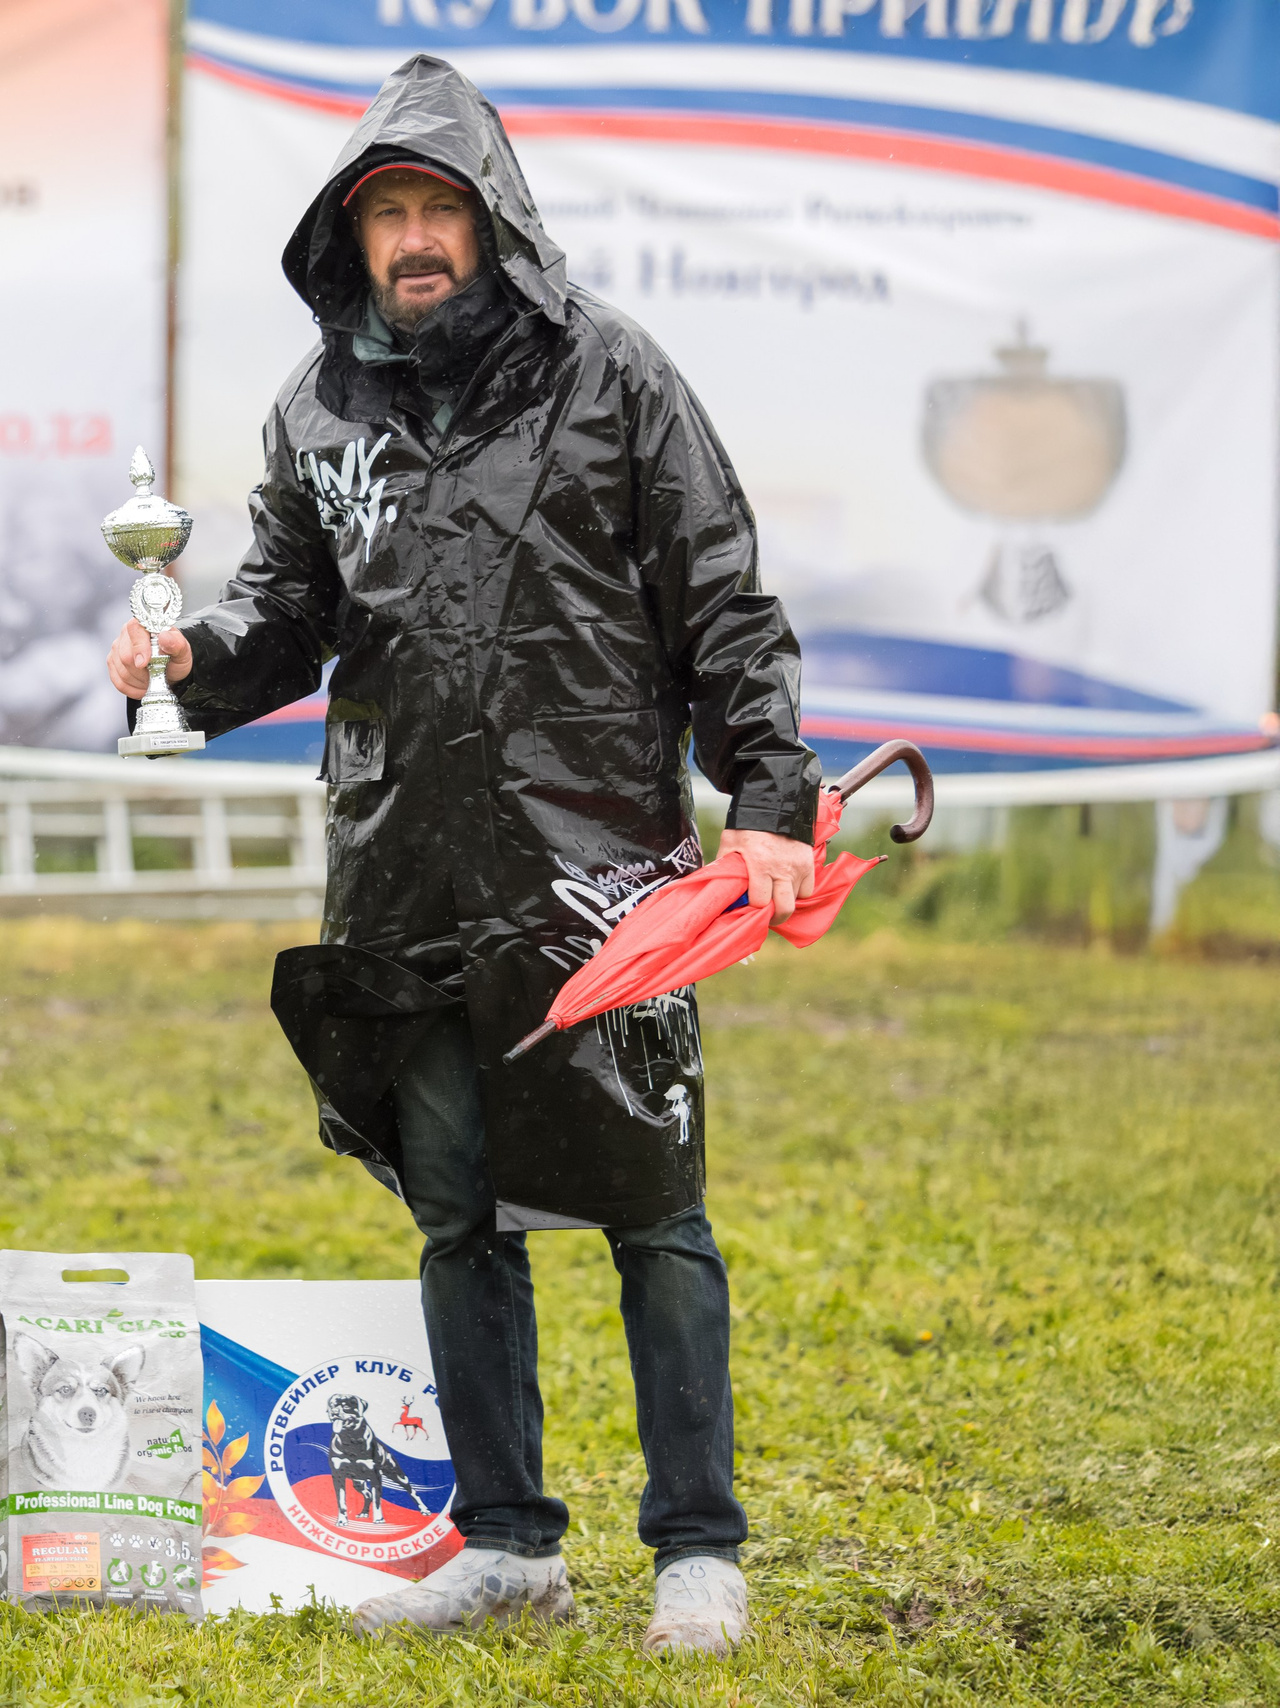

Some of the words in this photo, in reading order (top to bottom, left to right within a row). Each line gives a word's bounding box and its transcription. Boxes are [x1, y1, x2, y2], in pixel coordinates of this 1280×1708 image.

[270, 1364, 340, 1473] РОТВЕЙЛЕР
[355, 1360, 414, 1384] КЛУБ
[147, 1434, 181, 1446] natural
[136, 1446, 173, 1458] organic
[173, 1444, 193, 1454] food
[15, 1492, 100, 1511] Professional
[104, 1494, 134, 1510] Line
[137, 1496, 164, 1517] Dog
[166, 1499, 196, 1520] Food
[287, 1503, 447, 1560] НИЖЕГОРОДСКОЕ
[32, 1546, 89, 1557] REGULAR
